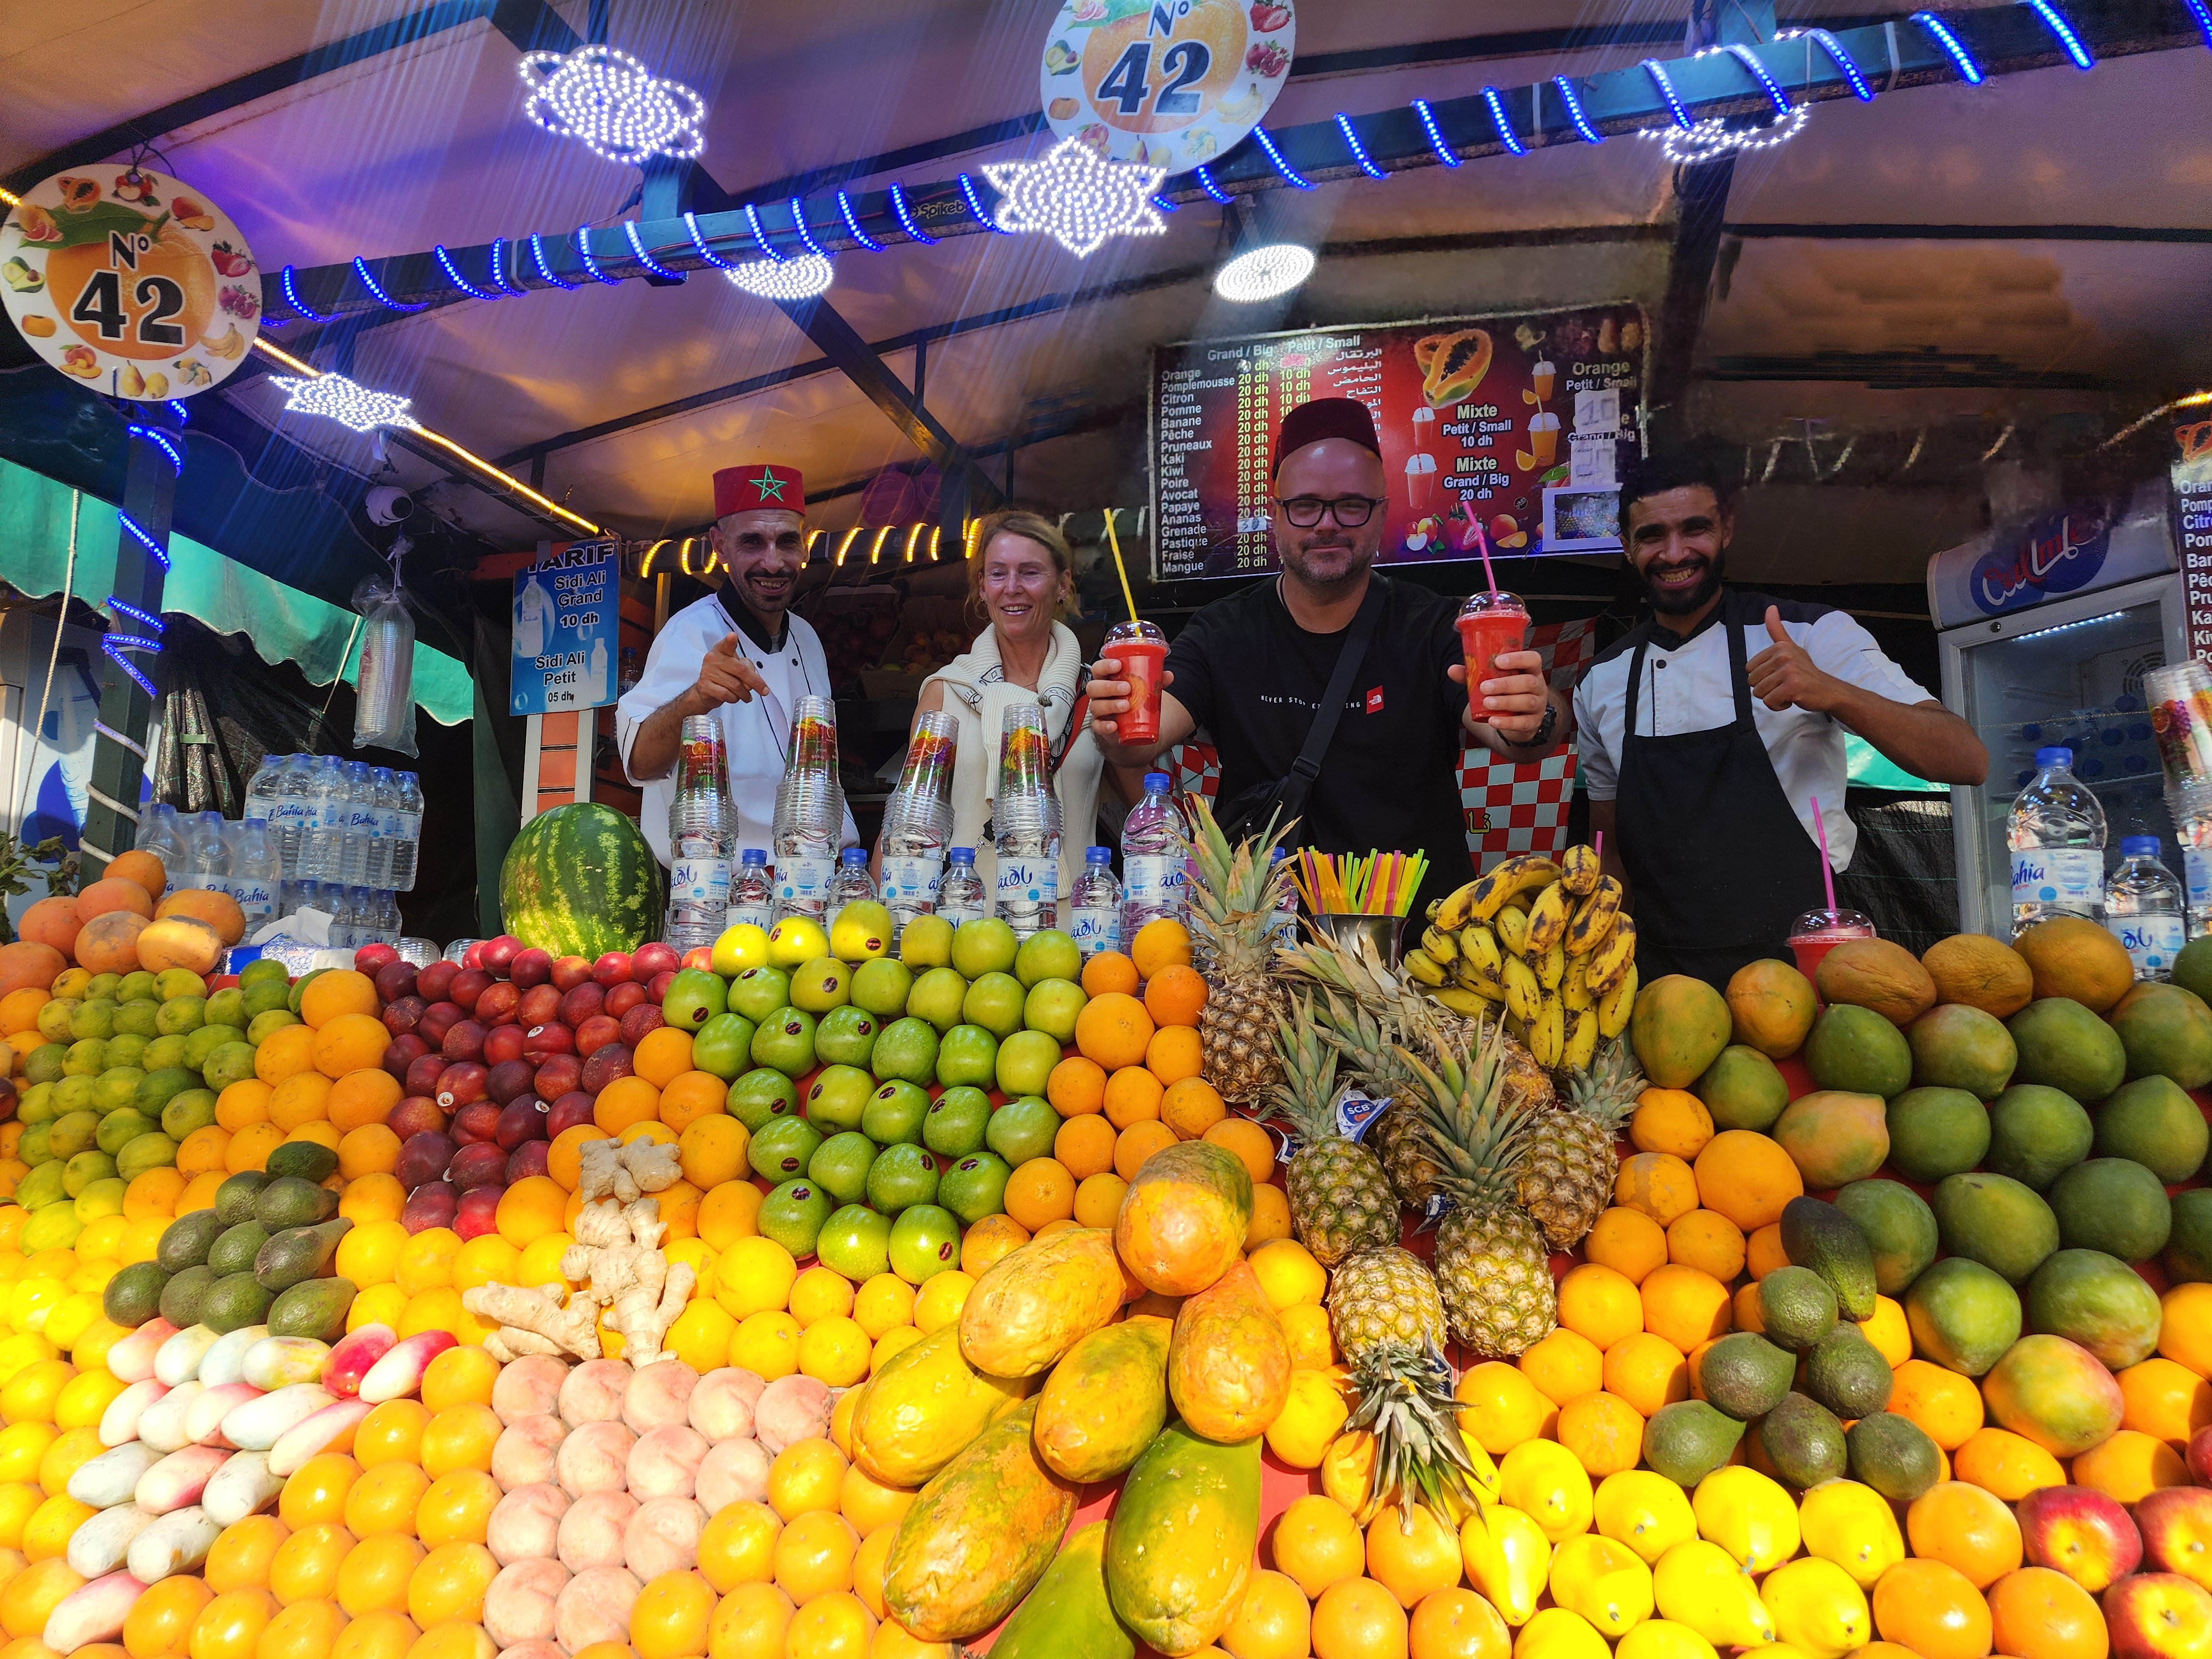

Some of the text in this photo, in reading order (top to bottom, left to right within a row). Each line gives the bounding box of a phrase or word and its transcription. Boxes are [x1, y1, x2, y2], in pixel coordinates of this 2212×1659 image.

[1098, 42, 1211, 113] 42
[920, 200, 968, 219] Spikeb
[74, 271, 184, 345] 42
[1208, 346, 1243, 361] Grand
[1253, 344, 1273, 357] Big
[1288, 340, 1316, 352] Petit
[1326, 335, 1360, 348] Small
[1162, 369, 1201, 381] Orange
[1254, 360, 1269, 371] dh
[1573, 362, 1630, 376] Orange
[1161, 368, 1311, 393] Pomplemousse 20 dh 10 dh
[1566, 379, 1594, 390] Petit
[1161, 380, 1311, 405] Citron 20 dh 10 dh
[1161, 405, 1202, 416] Pomme
[1238, 398, 1251, 409] 20
[1254, 396, 1269, 407] dh
[1279, 393, 1292, 405] 10
[1457, 404, 1498, 419] Mixte
[1161, 417, 1202, 429] Banane
[1238, 410, 1251, 421] 20
[1254, 408, 1269, 419] dh
[1443, 423, 1470, 435] Petit
[1479, 420, 1511, 432] Small
[1161, 420, 1268, 441] Pêche 20 dh
[1161, 432, 1268, 453] Pruneaux 20 dh
[1461, 435, 1493, 447] 10 dh
[1161, 445, 1268, 465] Kaki 20 dh
[1457, 456, 1497, 472] Mixte
[1161, 457, 1267, 477] Kiwi 20 dh
[1161, 469, 1267, 489] Poire 20 dh
[1444, 475, 1479, 488] Grand
[1489, 473, 1509, 486] Big
[1161, 482, 1267, 501] Avocat 20 dh
[1459, 488, 1492, 500] 20 dh
[1161, 494, 1267, 514] Papaye 20 dh
[1161, 507, 1267, 525] Ananas 20 dh
[2183, 514, 2212, 529] Citr
[1161, 524, 1207, 538] Grenade
[1162, 532, 1267, 550] Pastique 20 dh
[1162, 544, 1267, 561] Fraise 20 dh
[1162, 562, 1204, 574] Mangue
[1237, 557, 1249, 568] 20
[1253, 556, 1267, 567] dh
[555, 570, 606, 589] Sidi Ali
[558, 589, 602, 607] Grand
[561, 612, 598, 628] 10 dh
[2194, 630, 2212, 645] Ki
[535, 652, 585, 669] Sidi Ali
[544, 671, 576, 685] Petit
[547, 691, 572, 702] 05 dh
[1261, 695, 1282, 703] NEVER
[2011, 860, 2045, 888] ahia
[234, 888, 269, 904] Bahia
[1347, 1104, 1370, 1115] SCB
